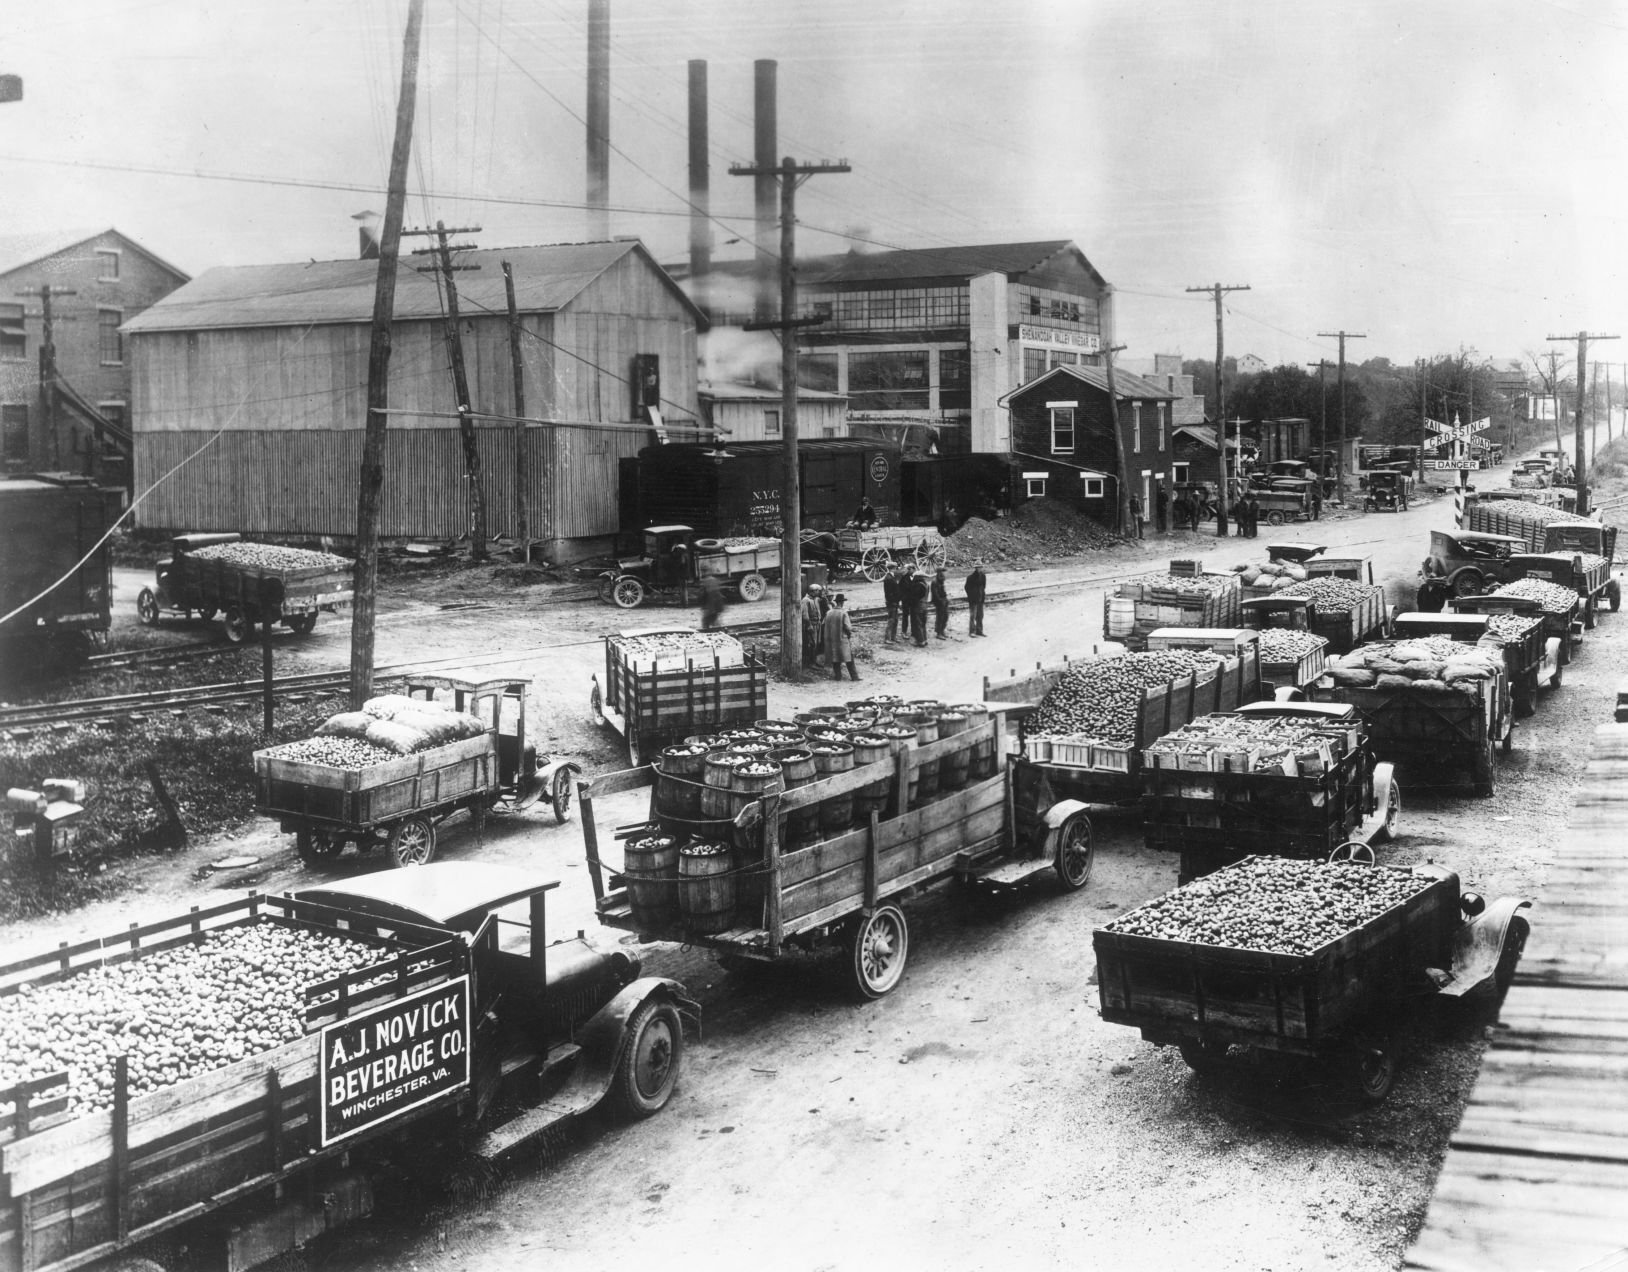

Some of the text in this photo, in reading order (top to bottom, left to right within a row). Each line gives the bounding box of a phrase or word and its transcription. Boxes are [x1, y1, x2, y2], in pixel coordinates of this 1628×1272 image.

[1424, 418, 1490, 449] RAIL ROAD
[1429, 420, 1484, 447] CROSSING
[753, 490, 780, 501] N.Y.C.
[375, 993, 460, 1051] NOVICK
[329, 1029, 466, 1107] BEVERAGE CO.
[432, 1067, 452, 1081] VA.
